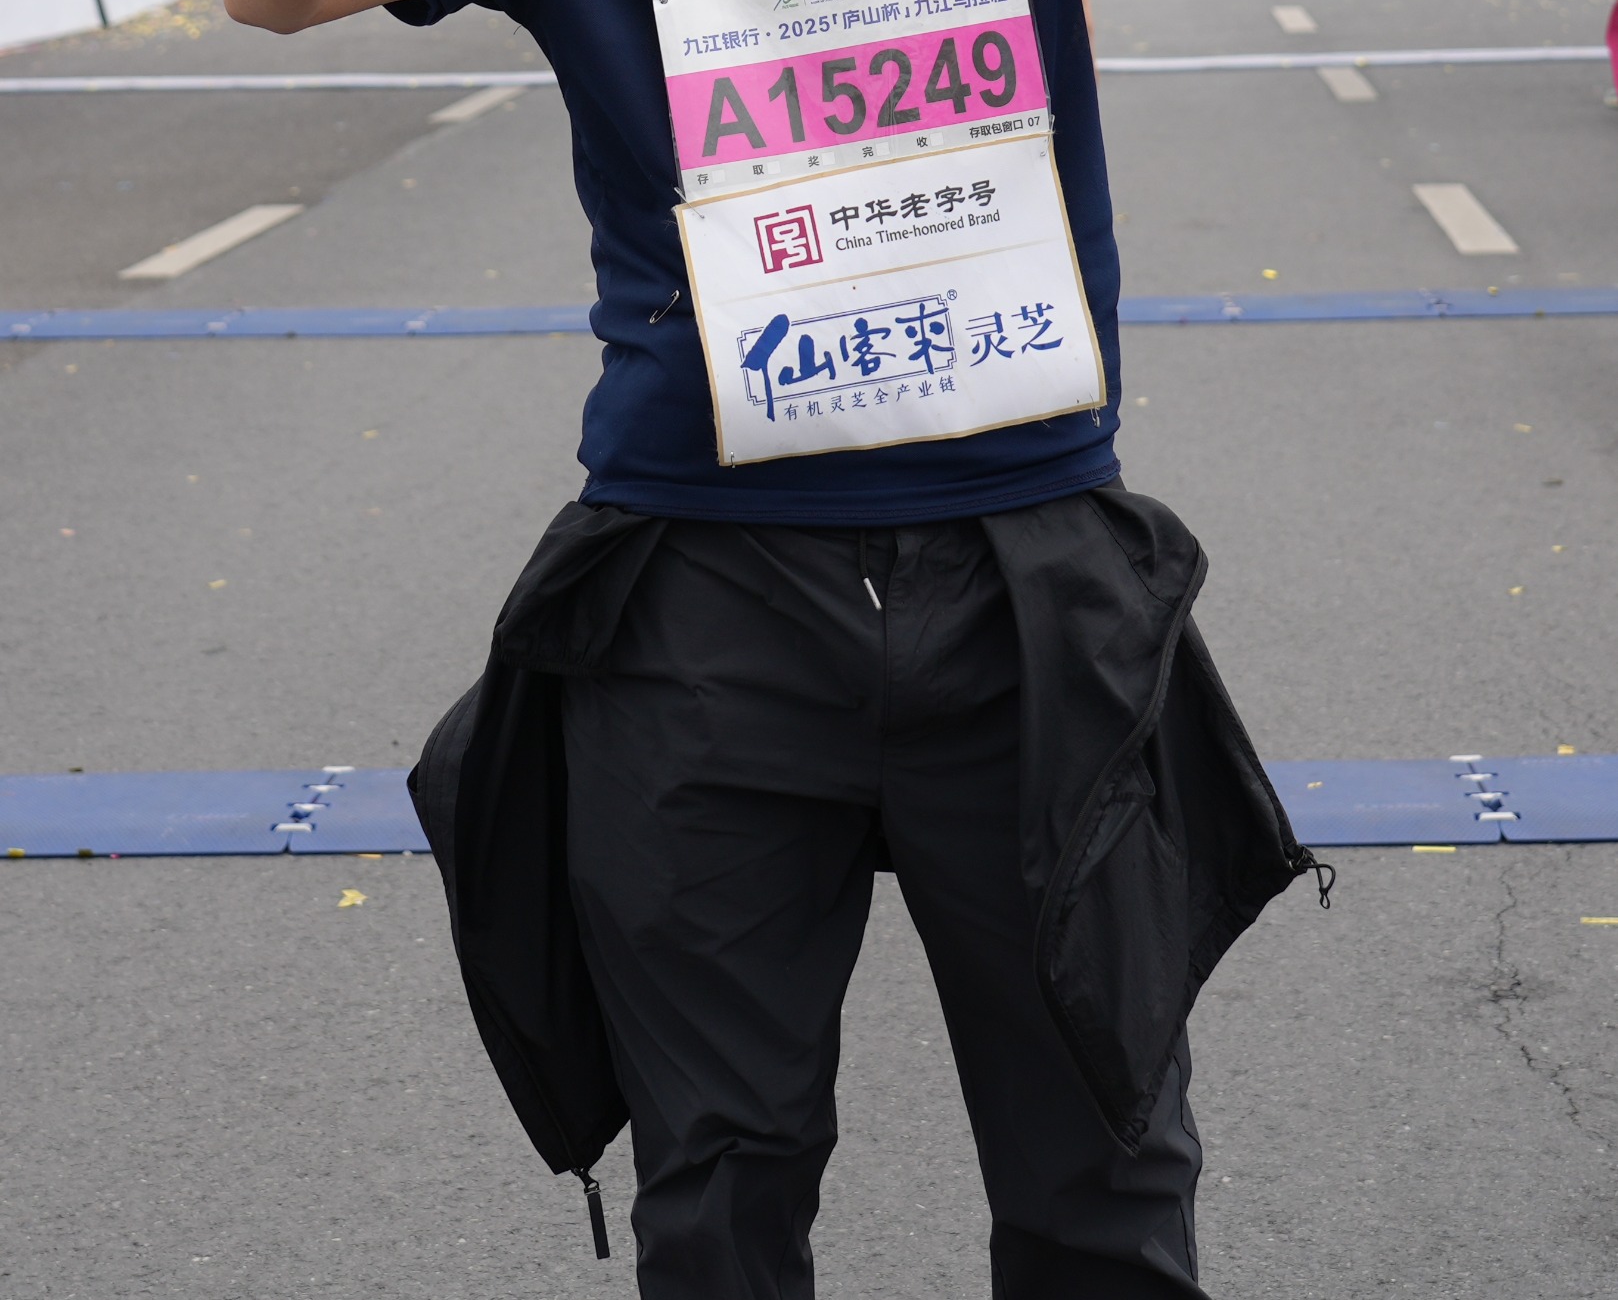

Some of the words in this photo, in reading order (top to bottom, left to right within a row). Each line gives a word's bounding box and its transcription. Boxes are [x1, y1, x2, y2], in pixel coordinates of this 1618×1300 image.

[702, 30, 1017, 158] A15249
[969, 118, 1024, 139] 存取包窗口
[1027, 115, 1041, 128] 07
[829, 179, 997, 231] 中华老字号
[835, 234, 873, 251] China
[876, 216, 965, 245] Time-honored
[968, 209, 1001, 228] Brand
[965, 301, 1065, 368] 灵芝
[783, 374, 957, 421] 有机灵芝全产业链
